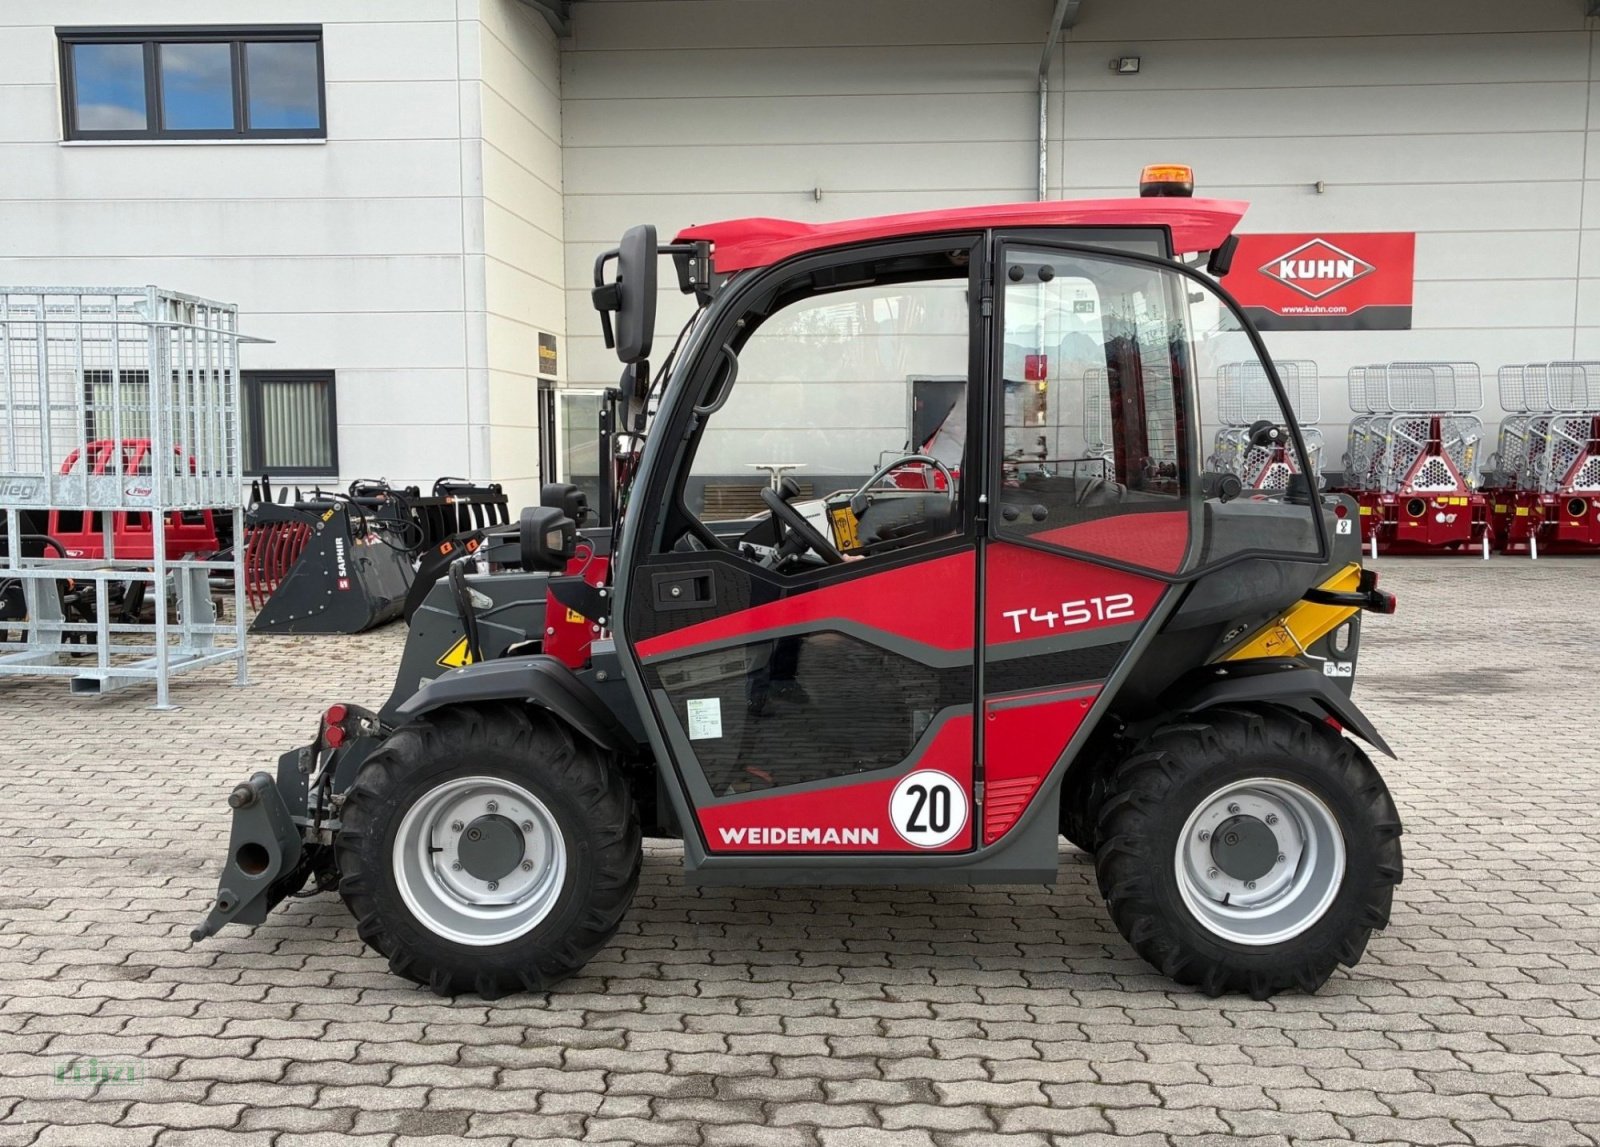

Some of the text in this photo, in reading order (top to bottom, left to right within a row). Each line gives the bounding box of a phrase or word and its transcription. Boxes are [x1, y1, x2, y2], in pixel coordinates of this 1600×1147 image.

[1280, 260, 1354, 279] KUHN
[1282, 305, 1347, 313] www.kuhn.com
[335, 537, 347, 577] SAPHIR
[1003, 593, 1135, 633] T4512
[906, 784, 951, 833] 20
[718, 827, 879, 845] WEIDEMANN
